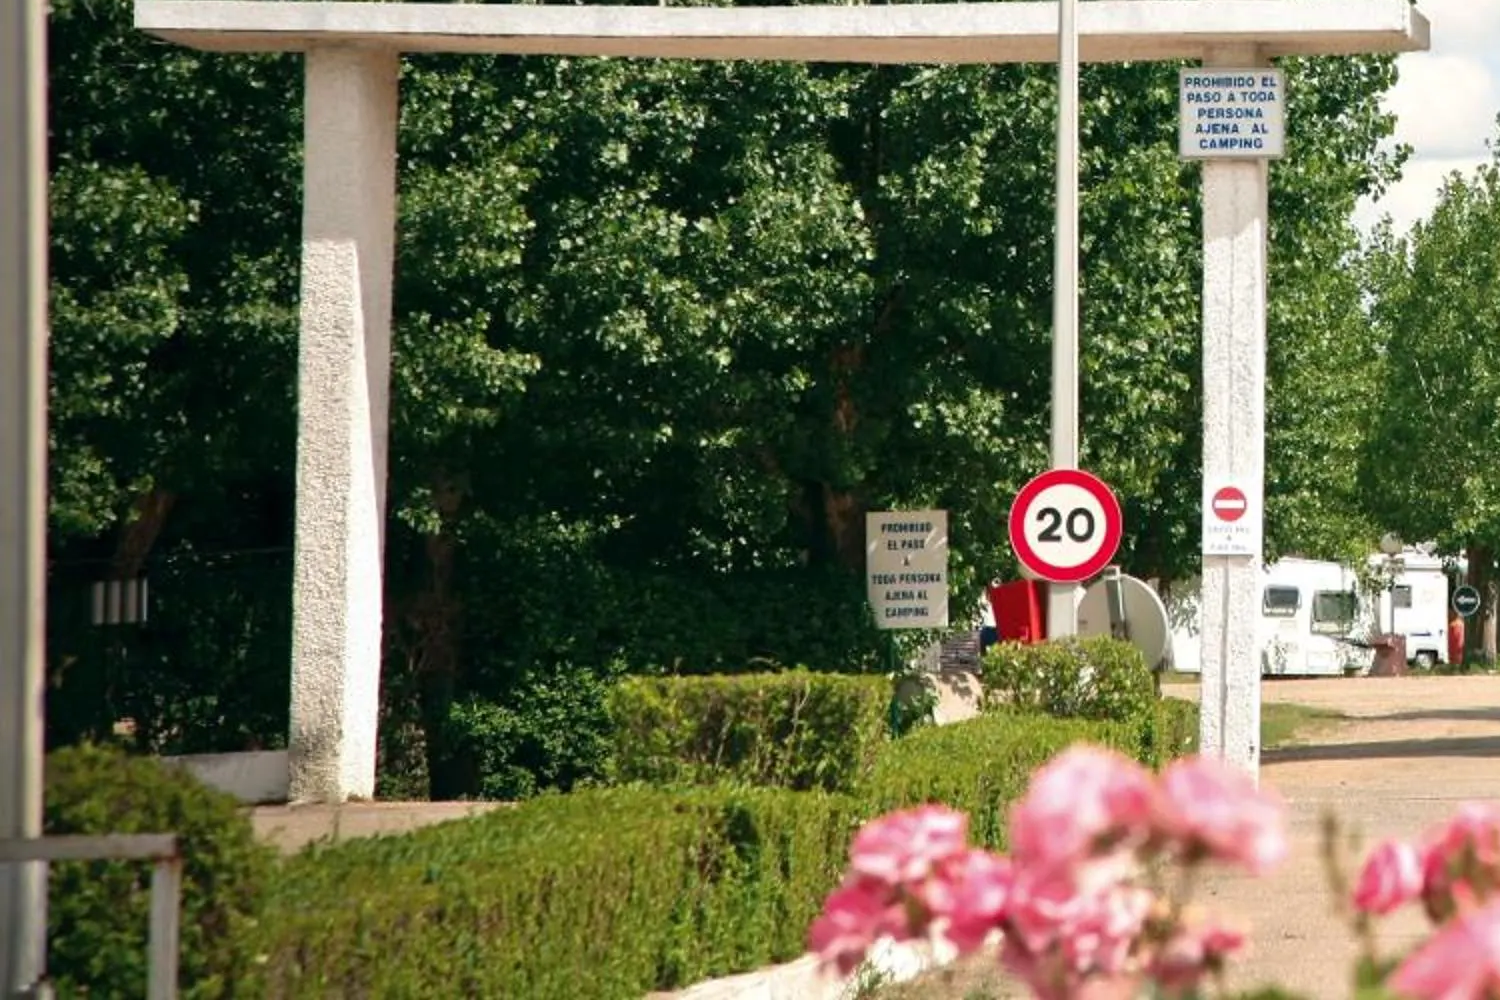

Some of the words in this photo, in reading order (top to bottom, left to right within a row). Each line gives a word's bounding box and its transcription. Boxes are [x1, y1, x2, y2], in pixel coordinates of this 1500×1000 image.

[1184, 76, 1256, 88] PROHIBIDO
[1261, 75, 1277, 87] EL
[1186, 91, 1222, 104] PASO
[1227, 91, 1236, 102] A
[1241, 91, 1276, 102] TODA
[1197, 107, 1264, 119] PERSONA
[1195, 123, 1240, 135] AJENA
[1251, 123, 1269, 134] AL
[1199, 138, 1264, 149] CAMPING
[1035, 507, 1095, 543] 20
